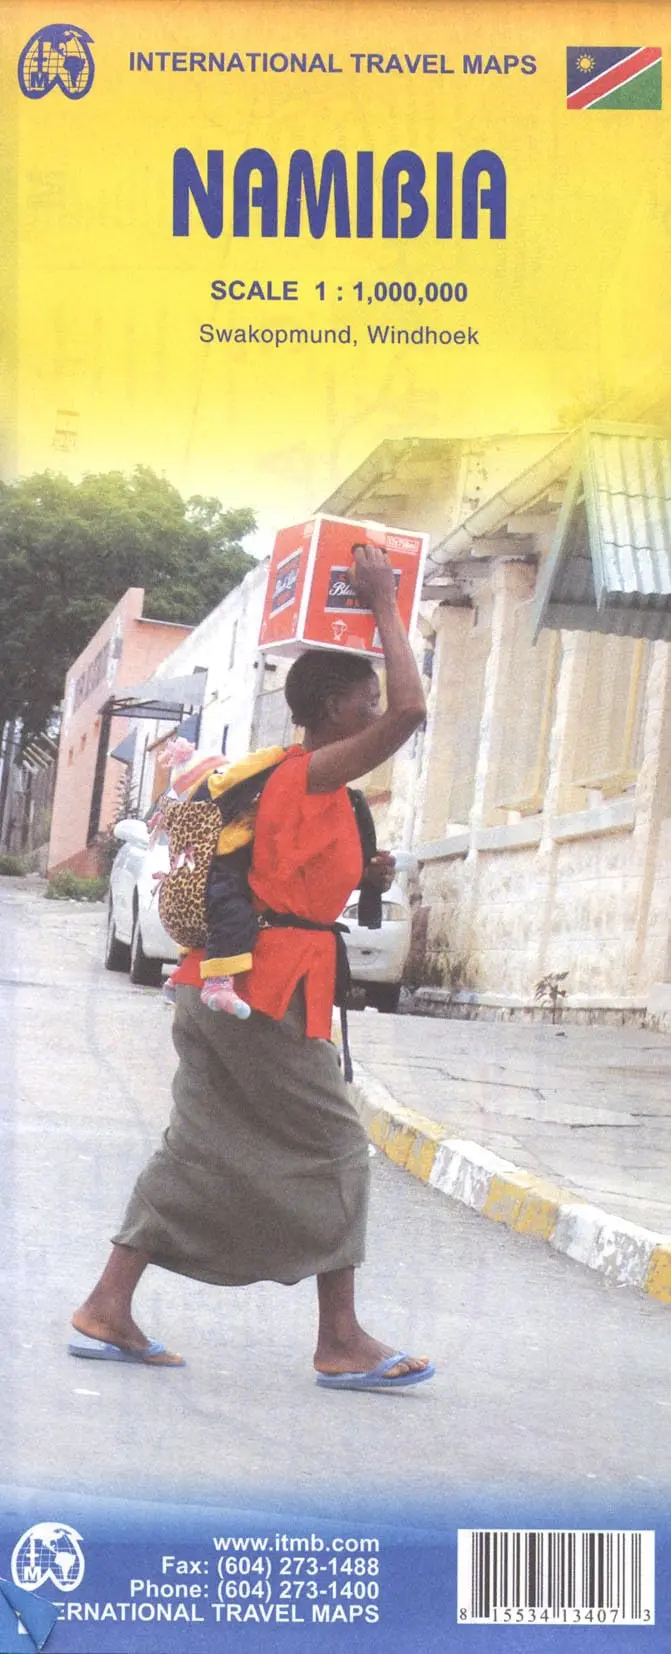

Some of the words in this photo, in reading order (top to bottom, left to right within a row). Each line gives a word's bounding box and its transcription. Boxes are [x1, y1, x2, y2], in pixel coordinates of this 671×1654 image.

[129, 51, 343, 73] INTERNATIONAL
[350, 53, 455, 75] TRAVEL
[462, 54, 537, 75] MAPS
[172, 147, 508, 240] NAMIBIA
[210, 279, 299, 302] SCALE
[315, 281, 325, 302] 1
[352, 281, 468, 306] 1,000,000
[199, 323, 358, 349] Swakopmund,
[367, 325, 480, 346] Windhoek
[213, 1533, 380, 1552] www.itmb.com
[162, 1556, 208, 1575] Fax:
[217, 1556, 272, 1579] (604)
[279, 1557, 380, 1576] 273-1488
[130, 1579, 208, 1598] Phone:
[217, 1580, 272, 1603] (604)
[279, 1580, 380, 1600] 273-1400
[52, 1602, 205, 1622] ERNATIONAL
[211, 1603, 305, 1622] TRAVEL
[312, 1604, 380, 1623] MAPS
[459, 1608, 468, 1621] 8
[493, 1608, 549, 1623] 15534
[562, 1608, 620, 1623] 13407
[643, 1609, 651, 1622] 3
